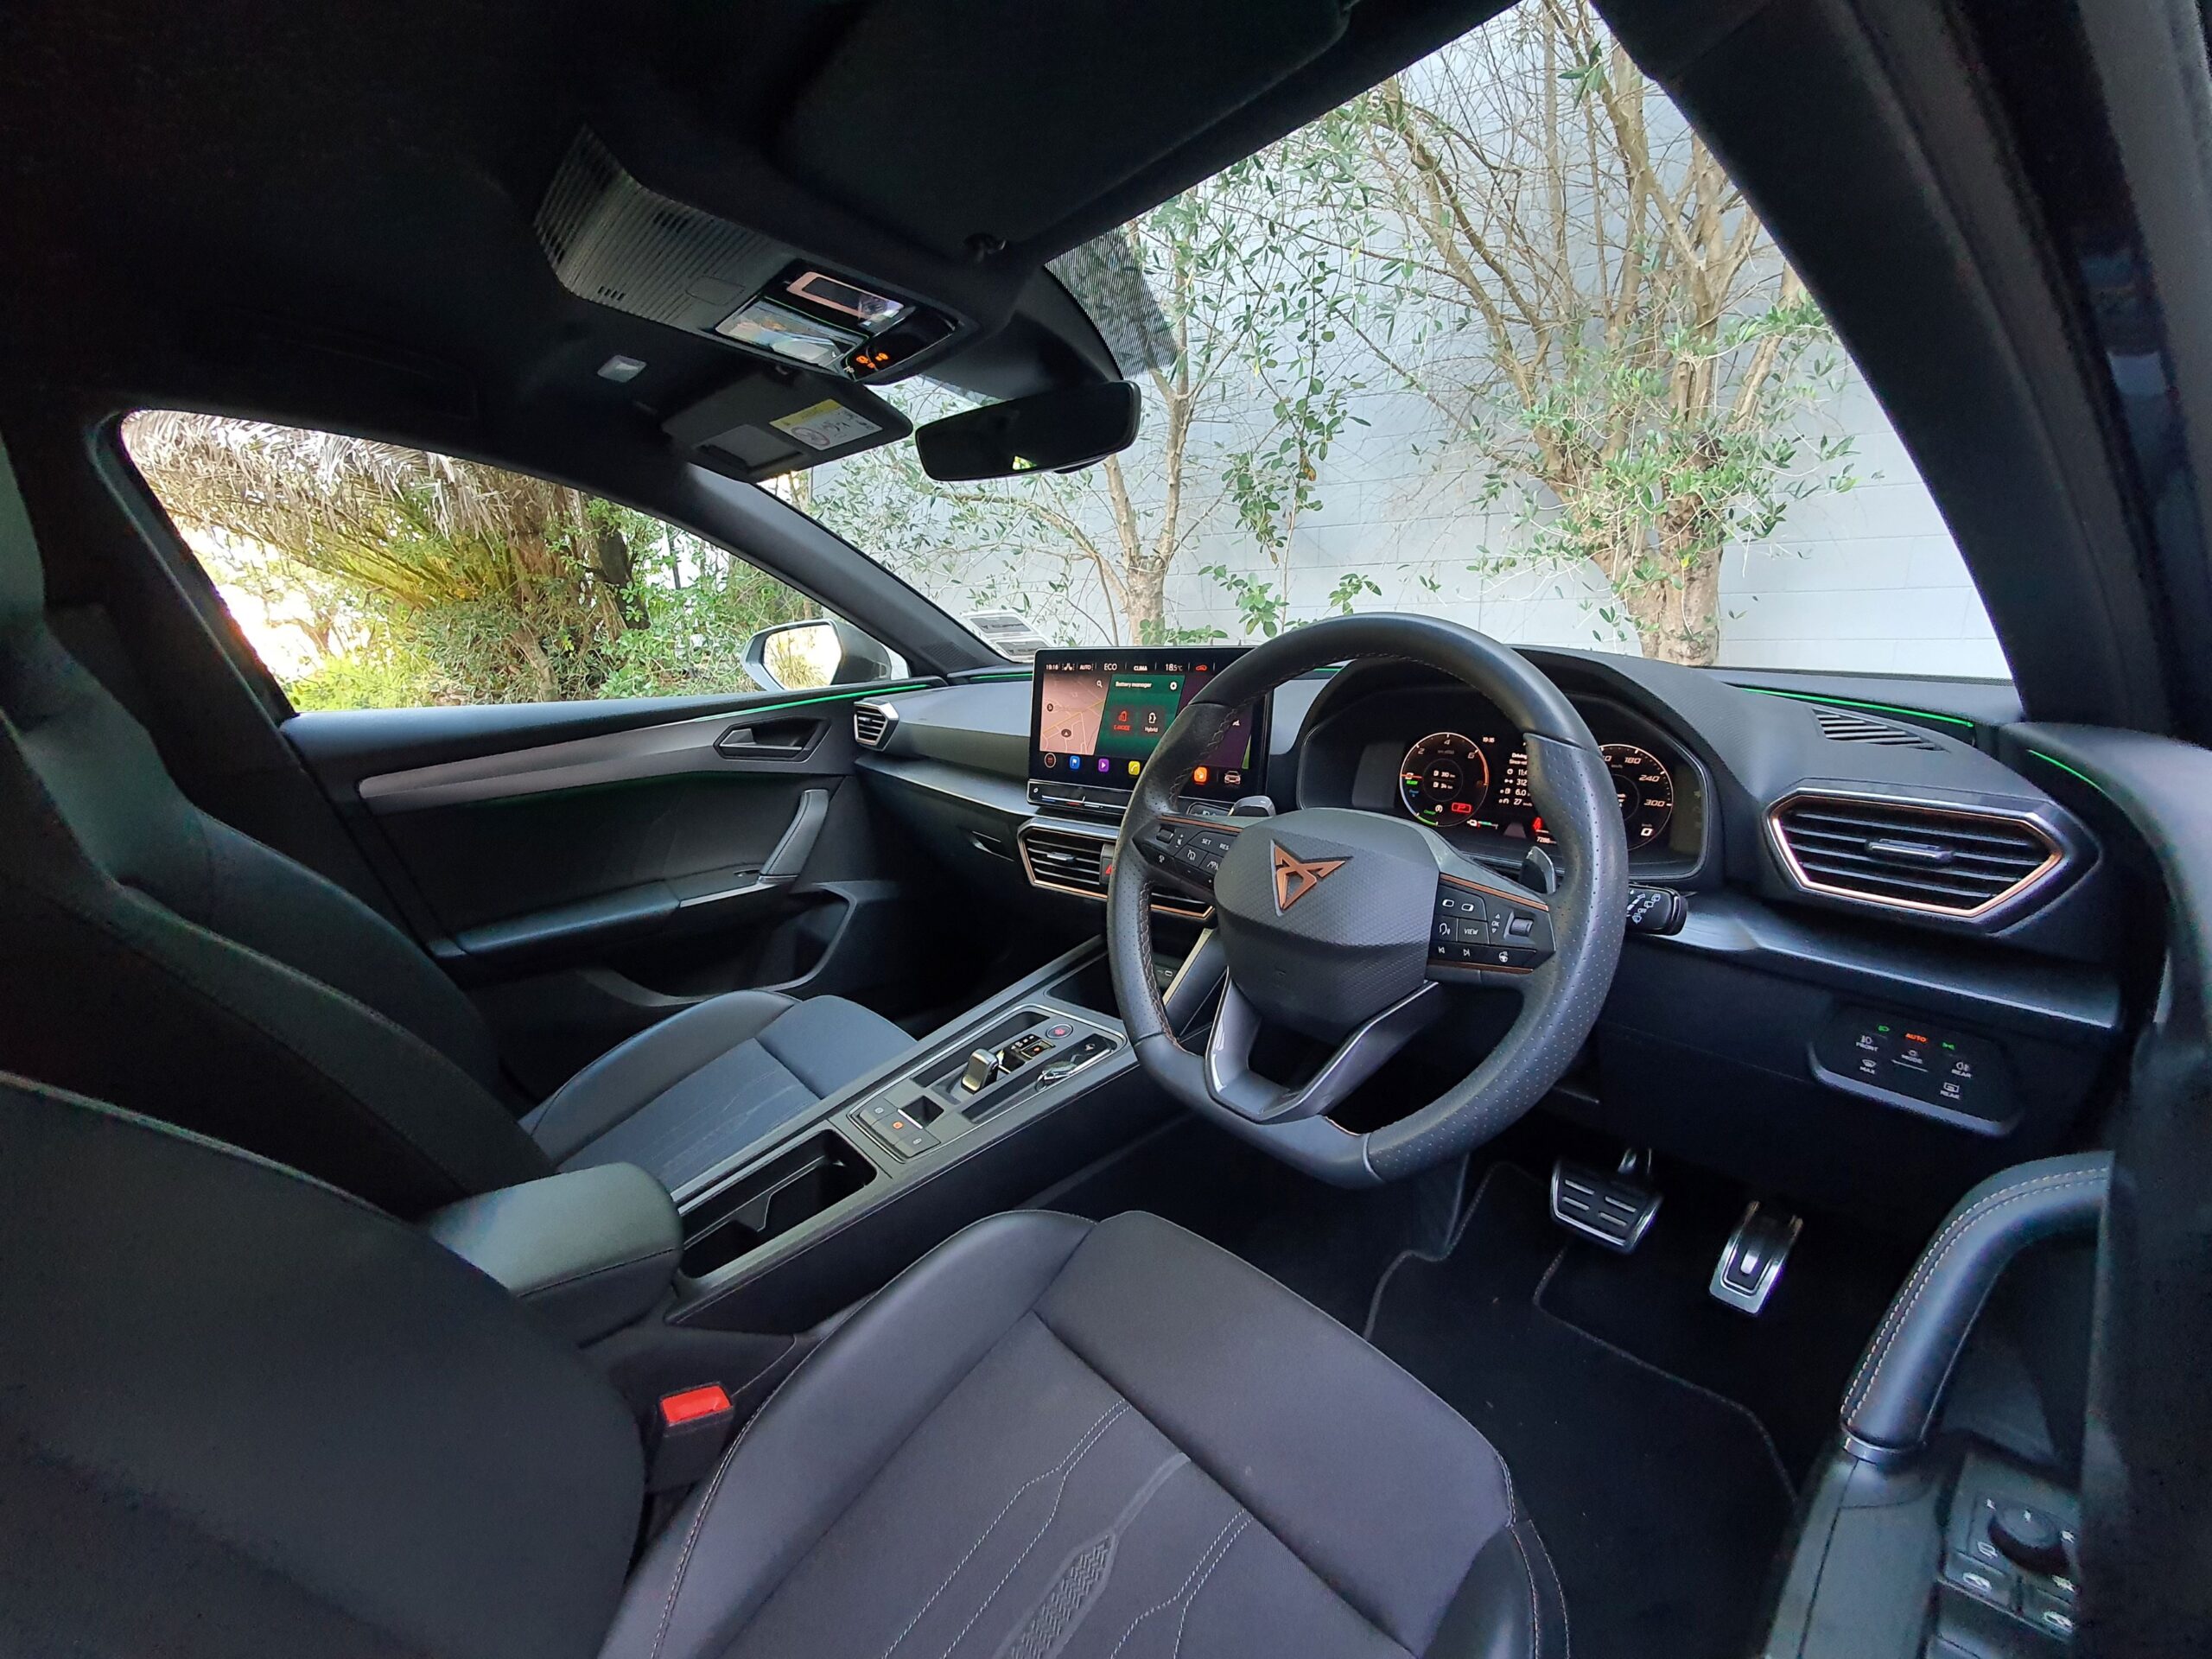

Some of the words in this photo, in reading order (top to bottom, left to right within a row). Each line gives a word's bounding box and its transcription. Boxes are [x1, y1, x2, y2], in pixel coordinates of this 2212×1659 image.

[1638, 774, 1661, 783] 240
[1515, 788, 1527, 797] 6.0
[1643, 798, 1666, 807] 300
[1640, 827, 1653, 836] 0
[1219, 842, 1230, 851] RES
[1905, 1033, 1928, 1043] AUTO
[1855, 1041, 1878, 1052] FRONT
[1901, 1053, 1923, 1065] MODE
[1859, 1065, 1876, 1075] MAX
[1951, 1068, 1972, 1079] REAR
[1940, 1090, 1961, 1100] REAR
